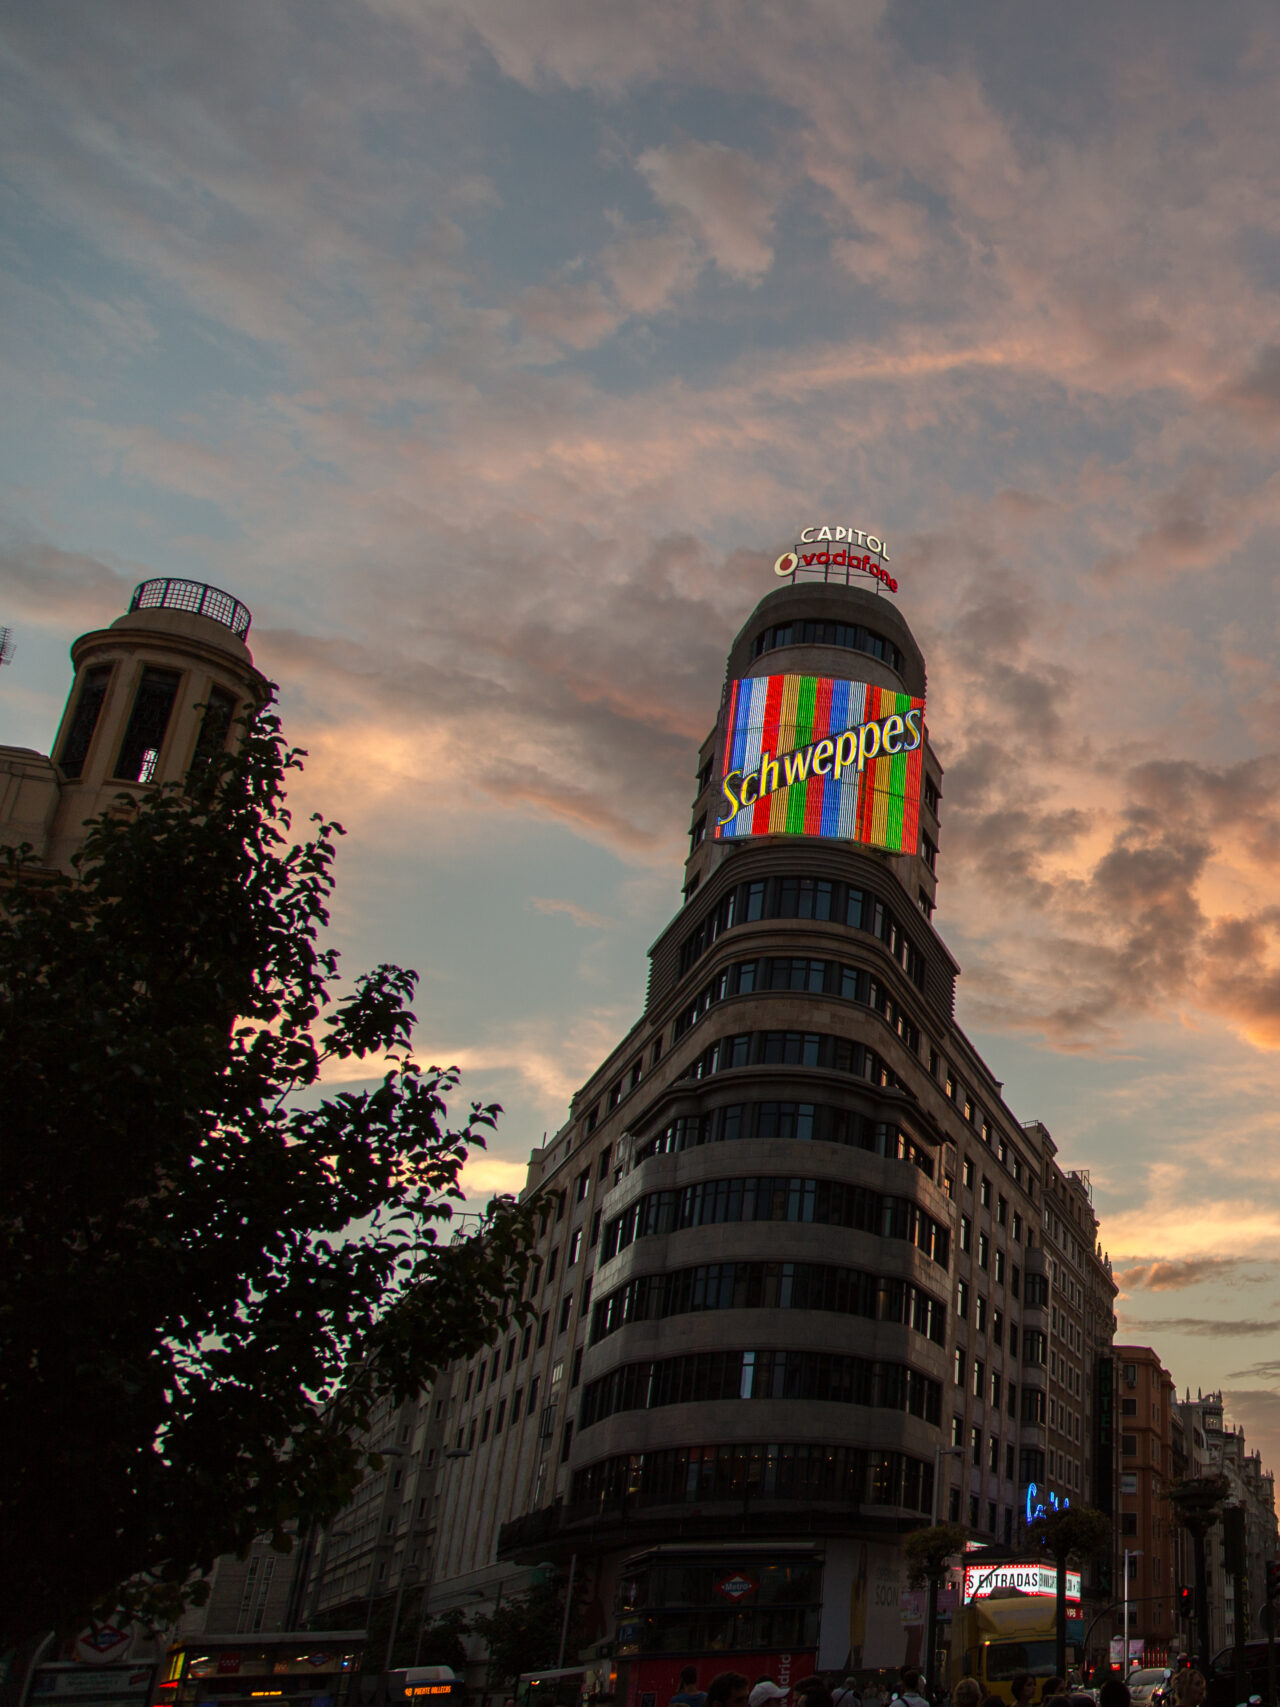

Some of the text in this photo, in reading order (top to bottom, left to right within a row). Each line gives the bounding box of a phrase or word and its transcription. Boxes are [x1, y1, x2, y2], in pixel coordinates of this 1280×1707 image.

[800, 525, 891, 561] CAPITOL
[801, 549, 898, 593] vodafone
[717, 709, 922, 825] Schweppes
[725, 1581, 748, 1593] Metro
[979, 1572, 1039, 1590] ENTRADAS
